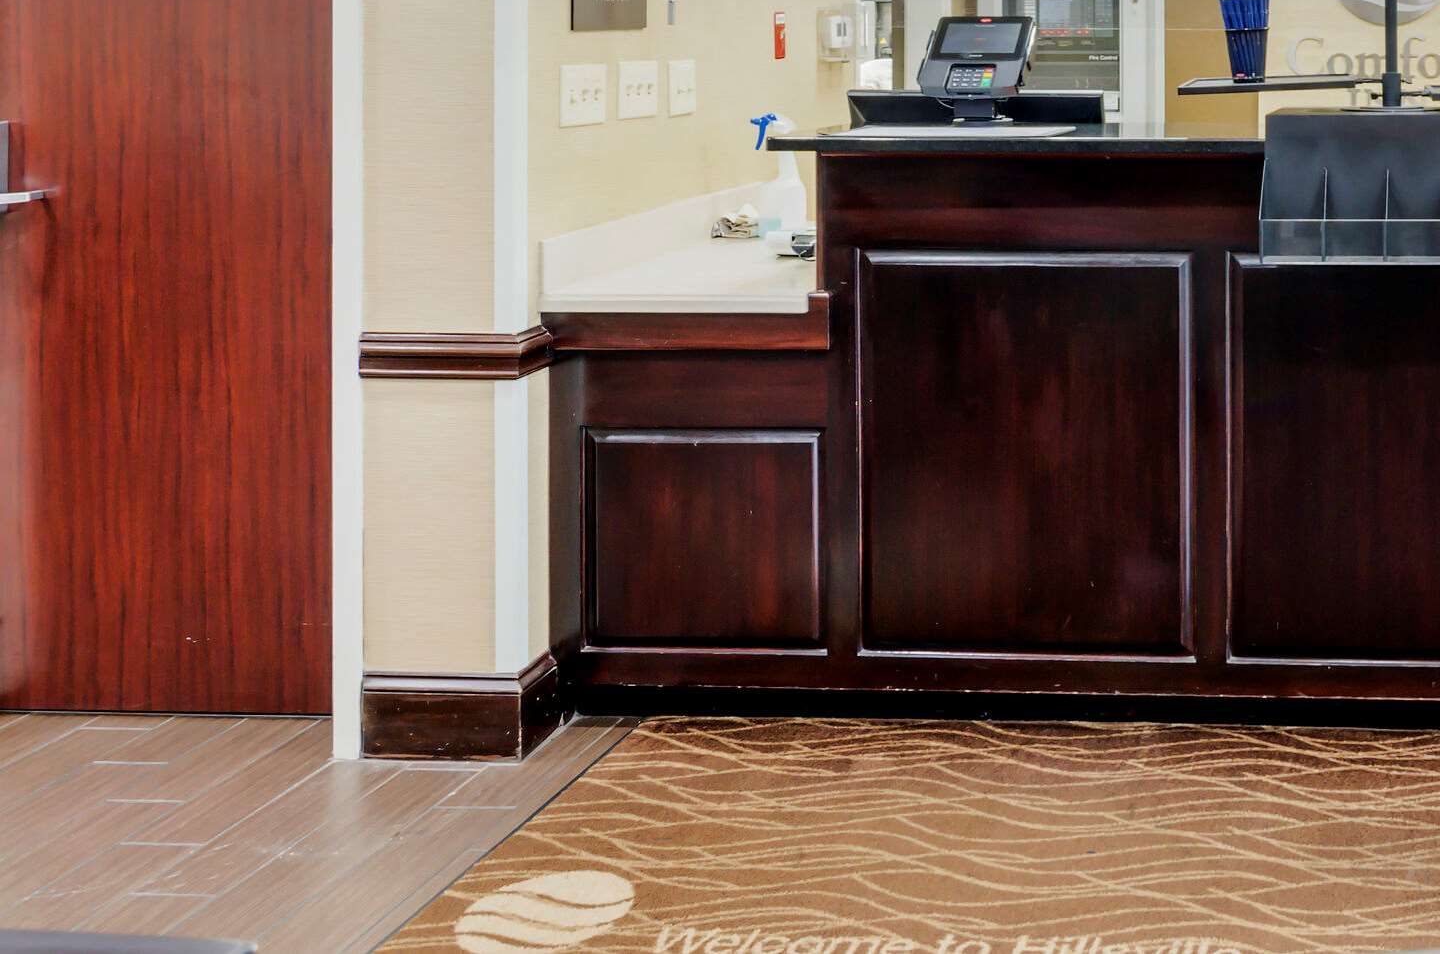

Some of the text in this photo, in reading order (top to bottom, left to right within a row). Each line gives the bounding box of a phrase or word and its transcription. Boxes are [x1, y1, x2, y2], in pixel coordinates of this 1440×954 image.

[654, 925, 1242, 954] Welcome to Hillsill
